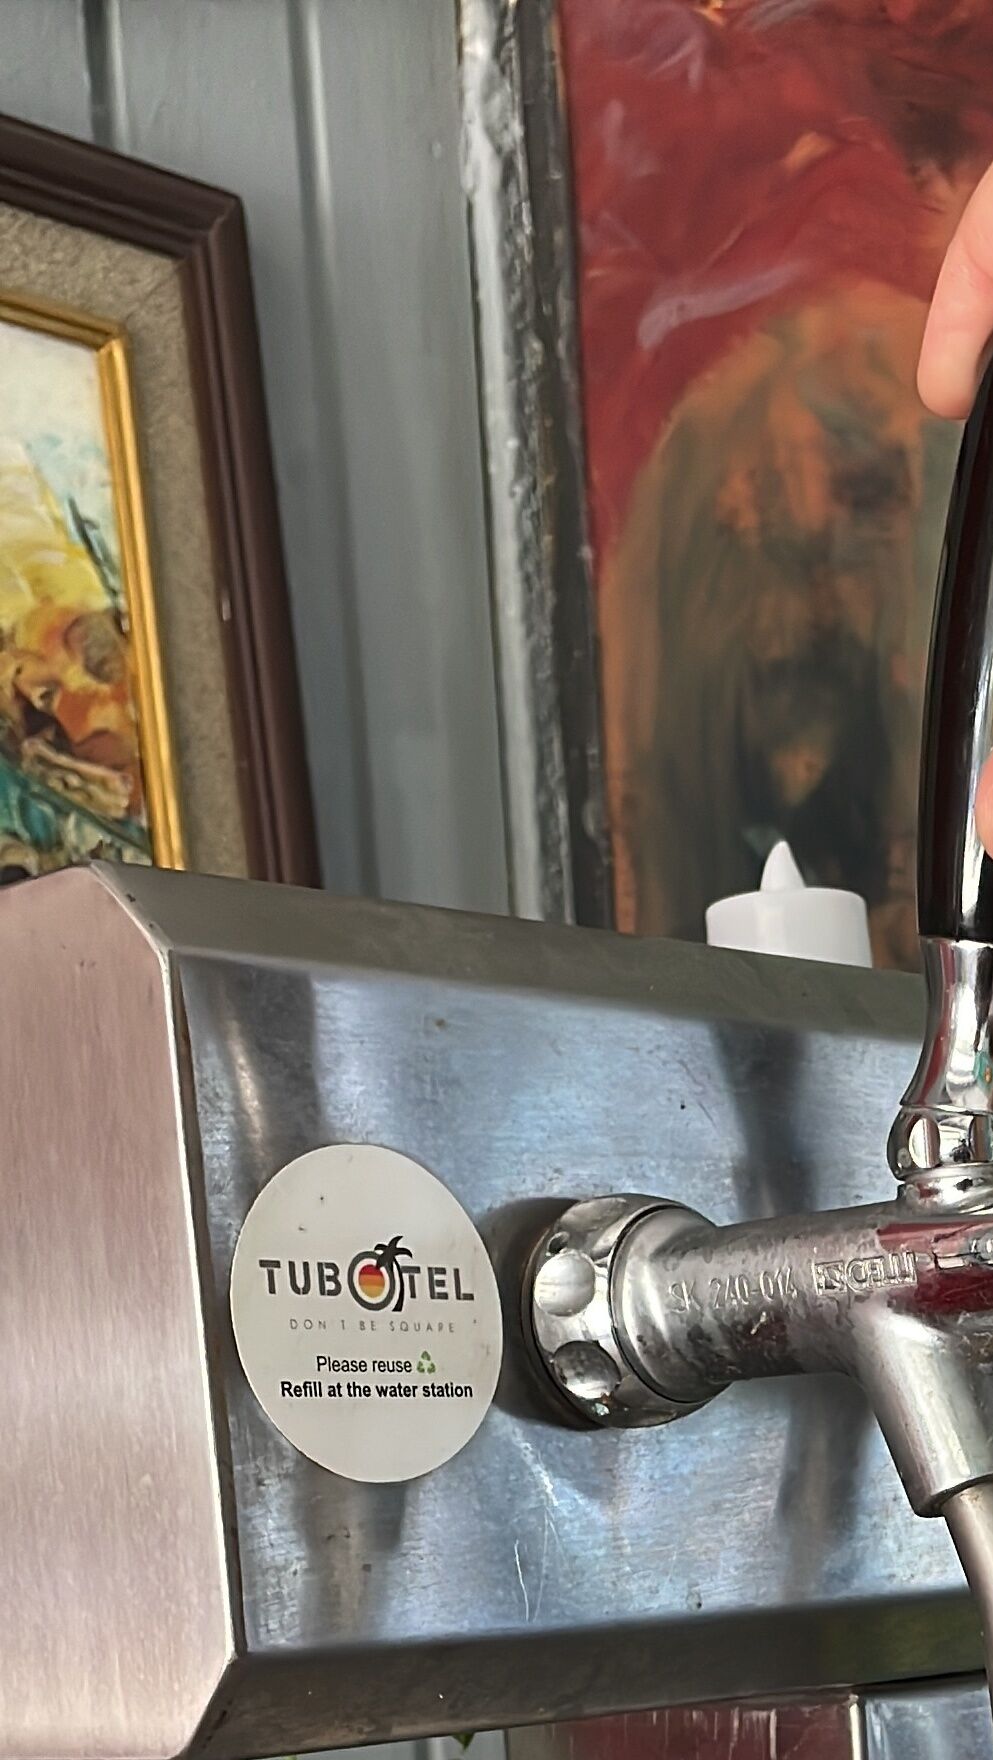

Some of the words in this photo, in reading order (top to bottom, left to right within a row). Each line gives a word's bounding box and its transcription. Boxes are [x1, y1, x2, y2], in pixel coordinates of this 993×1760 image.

[259, 1236, 475, 1312] TUBOTEL
[289, 1318, 346, 1330] DONT
[359, 1320, 377, 1332] BE
[388, 1321, 455, 1333] SQUARE
[316, 1355, 368, 1373] Please
[372, 1359, 413, 1373] reuse
[280, 1381, 323, 1398] Refill
[327, 1382, 343, 1398] at
[346, 1382, 372, 1398] the
[376, 1384, 418, 1398] water
[422, 1382, 473, 1398] station
